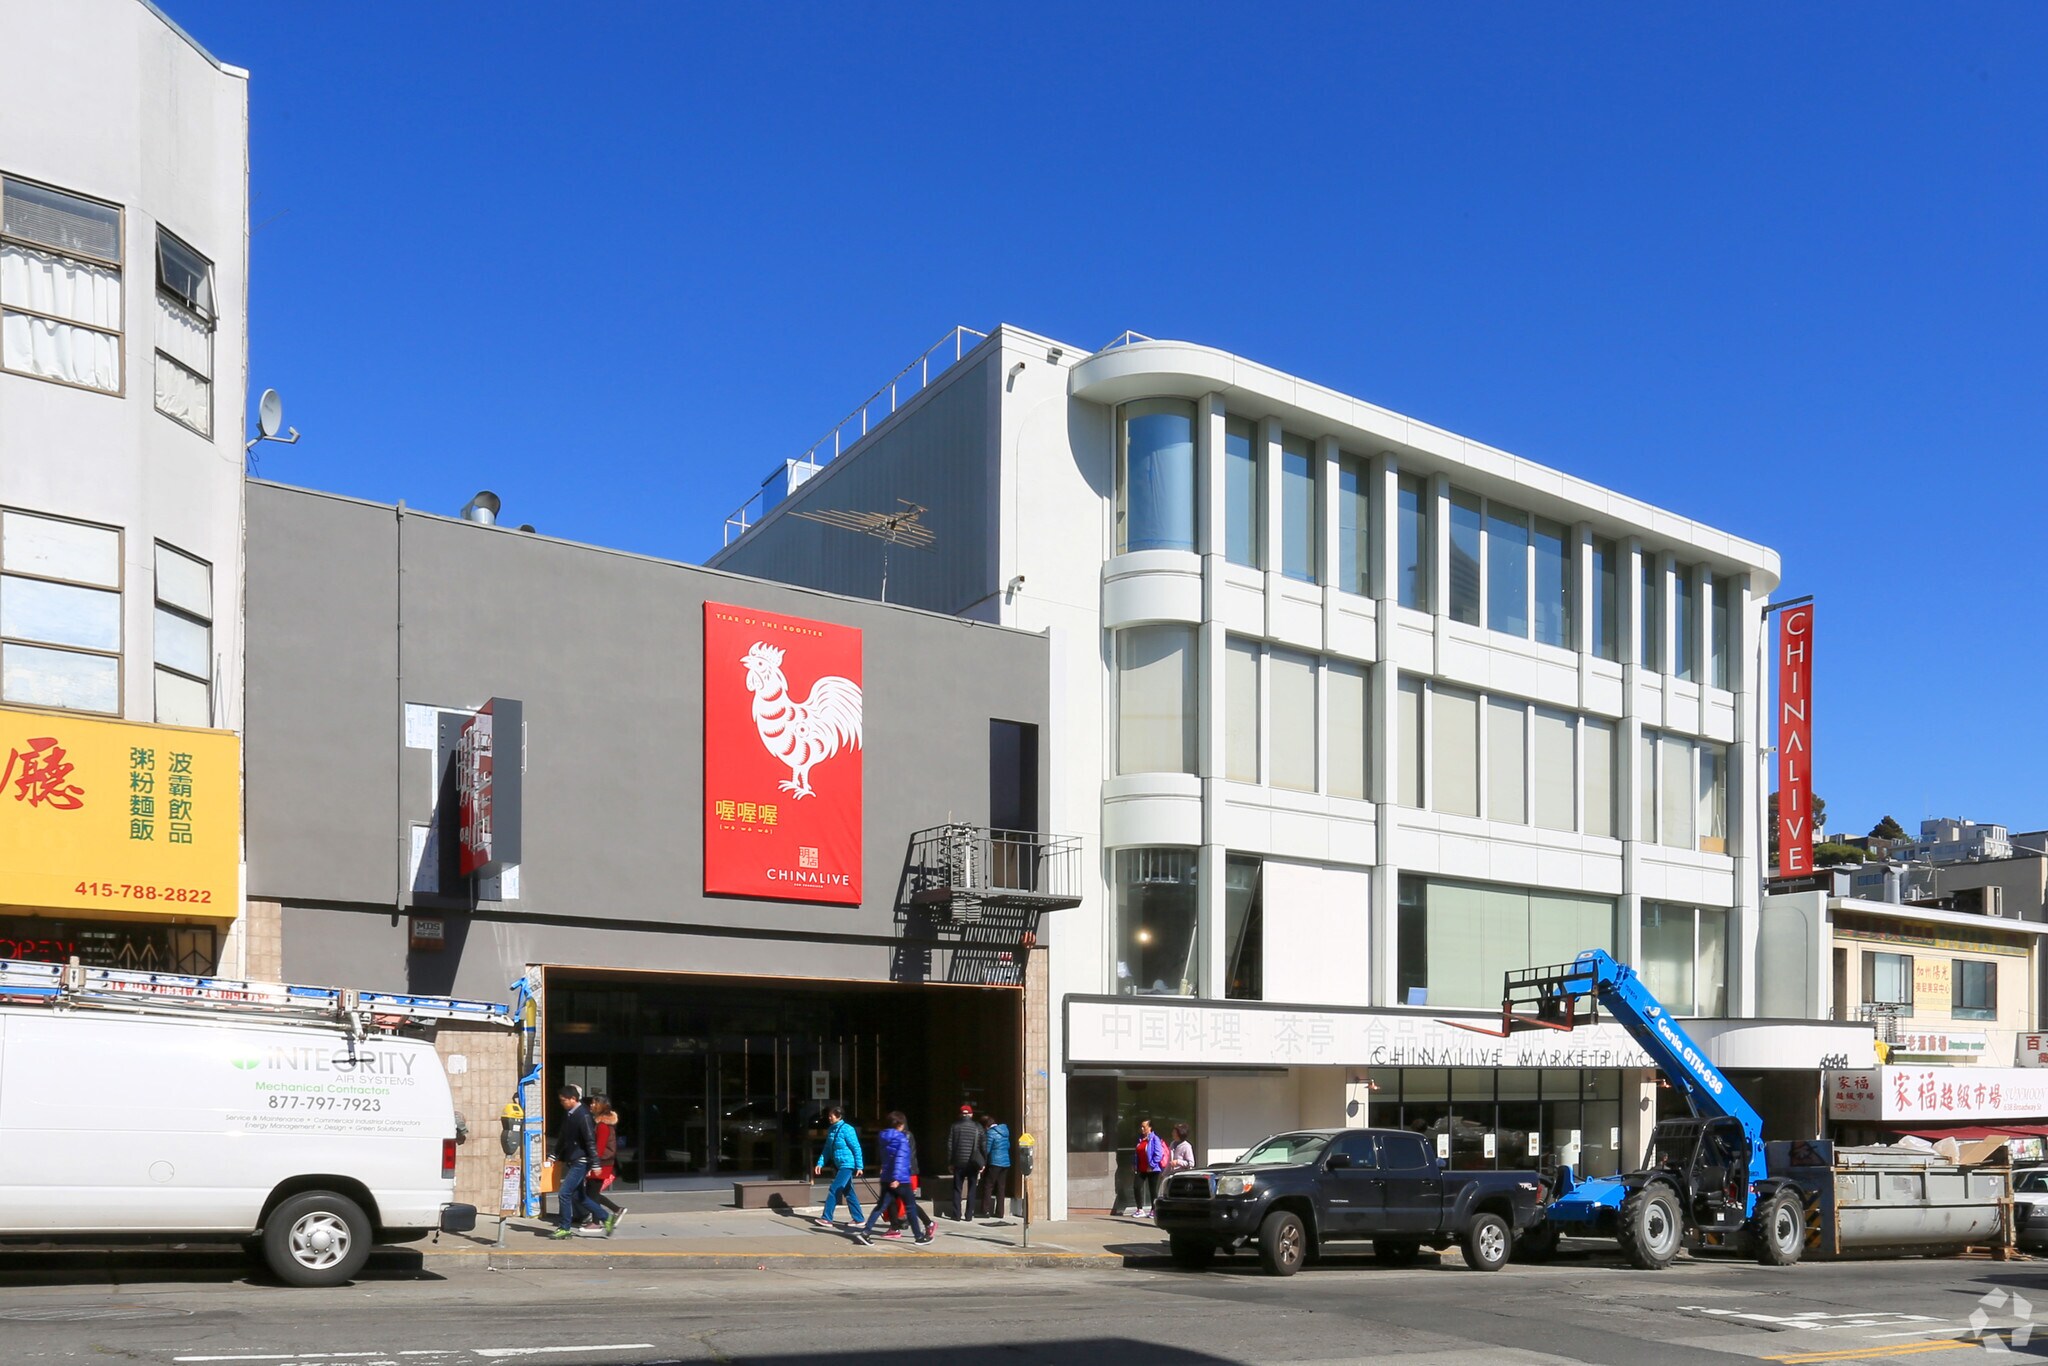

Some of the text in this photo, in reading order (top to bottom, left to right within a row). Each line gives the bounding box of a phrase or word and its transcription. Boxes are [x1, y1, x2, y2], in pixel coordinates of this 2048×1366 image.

[716, 613, 739, 623] YEAR
[762, 621, 777, 629] THE
[783, 625, 823, 637] ROOSTER
[130, 747, 155, 841] 粥粉麵飯
[168, 751, 192, 844] 波霸飲品
[715, 800, 778, 826] 喔喔喔
[74, 881, 212, 904] 415-788-2822
[1101, 1005, 1242, 1051] 中国料理
[1274, 1014, 1335, 1056] 茶亭
[1658, 1018, 1723, 1094] Genie GTH-636
[255, 1081, 390, 1096] Mechanical Contractors
[335, 1074, 415, 1086] AIR SYSTEMS
[1838, 1076, 1869, 1090] 家福
[268, 1095, 382, 1112] 877-797-7923
[270, 1122, 315, 1130] Management
[355, 1117, 384, 1125] Industrial
[385, 1118, 421, 1126] Contractors
